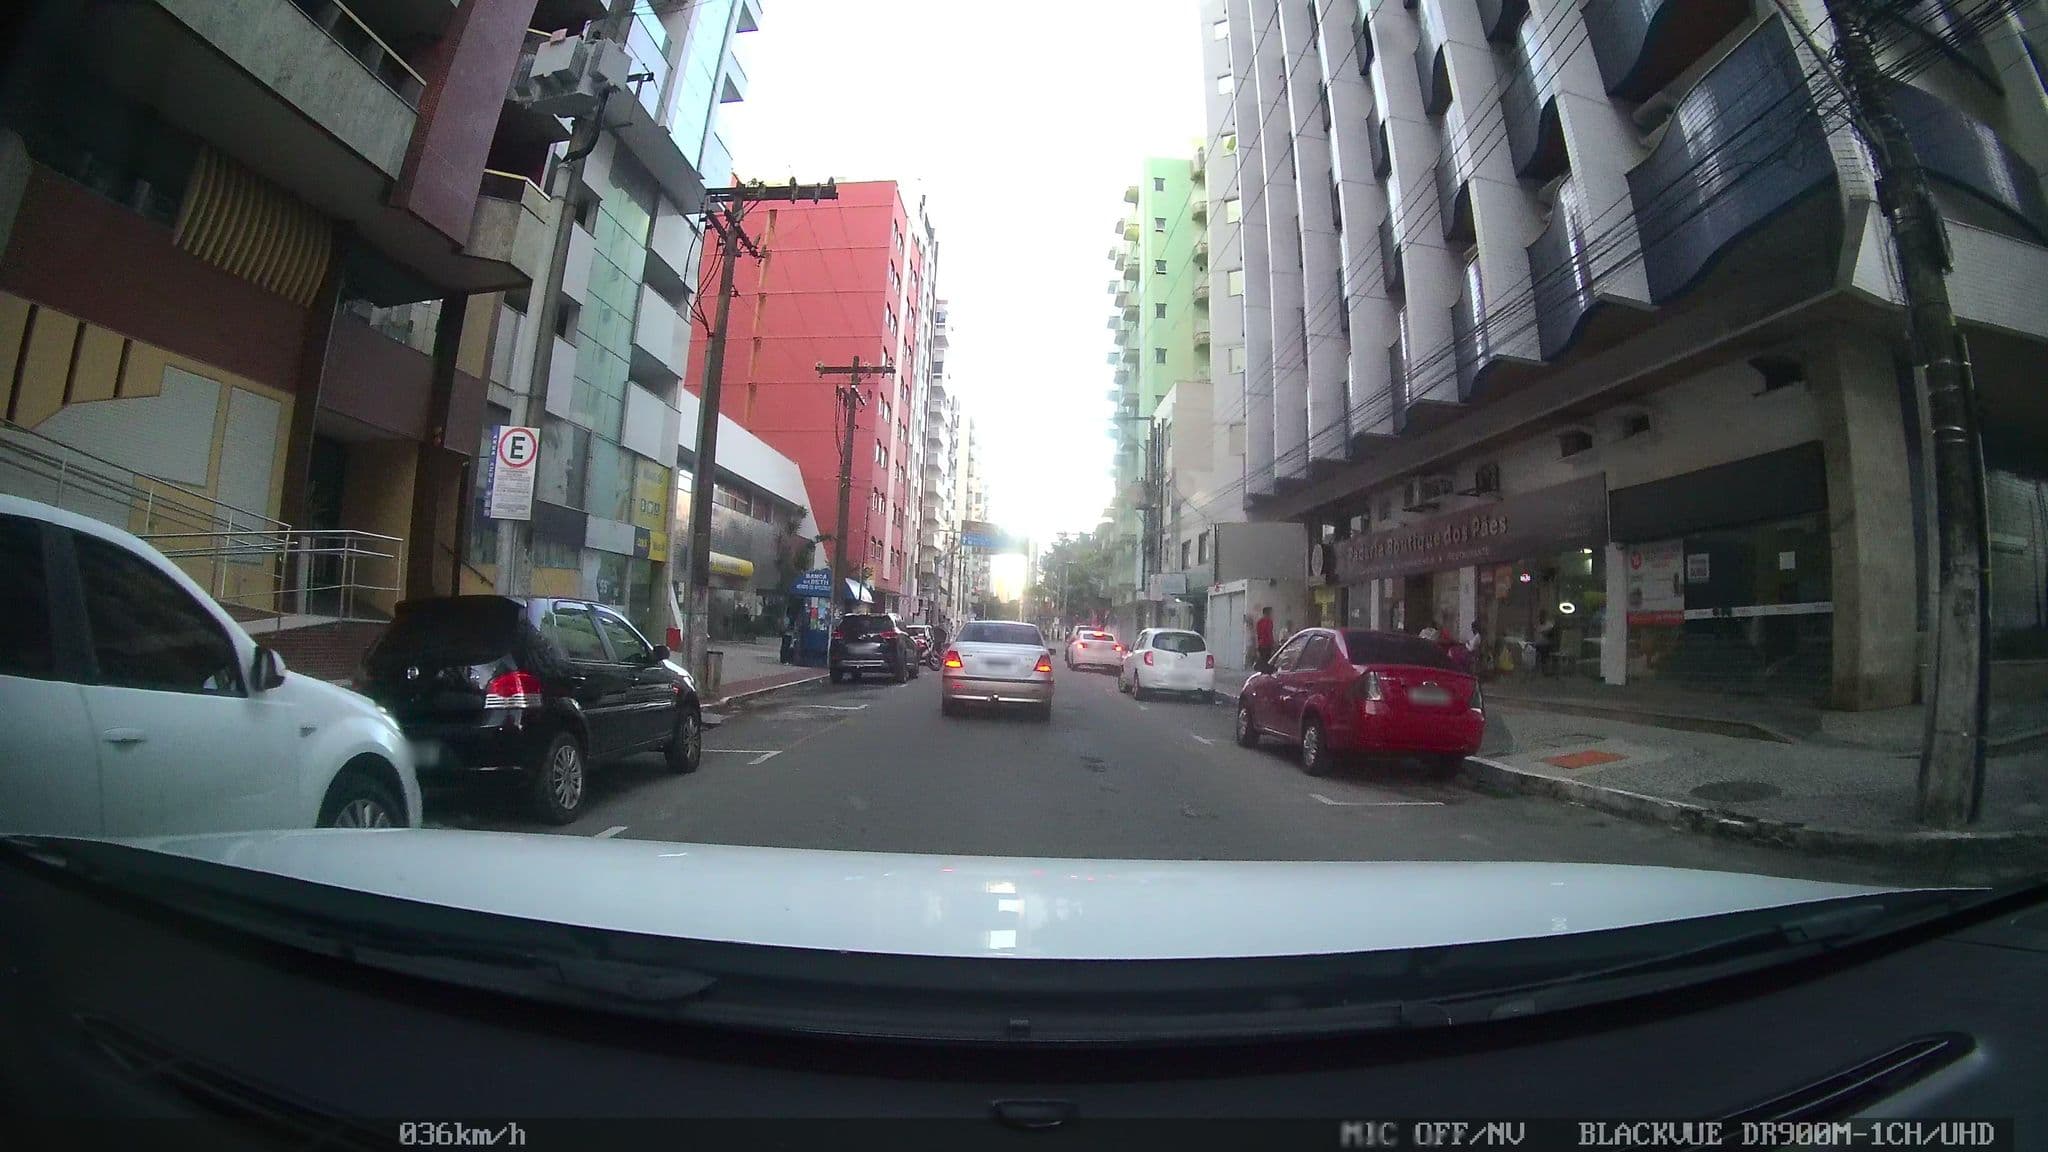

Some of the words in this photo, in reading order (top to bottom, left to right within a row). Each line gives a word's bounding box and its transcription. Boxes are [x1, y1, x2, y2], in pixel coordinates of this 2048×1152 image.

[510, 436, 525, 459] E
[1387, 533, 1441, 555] Boutique
[1443, 524, 1469, 546] dos
